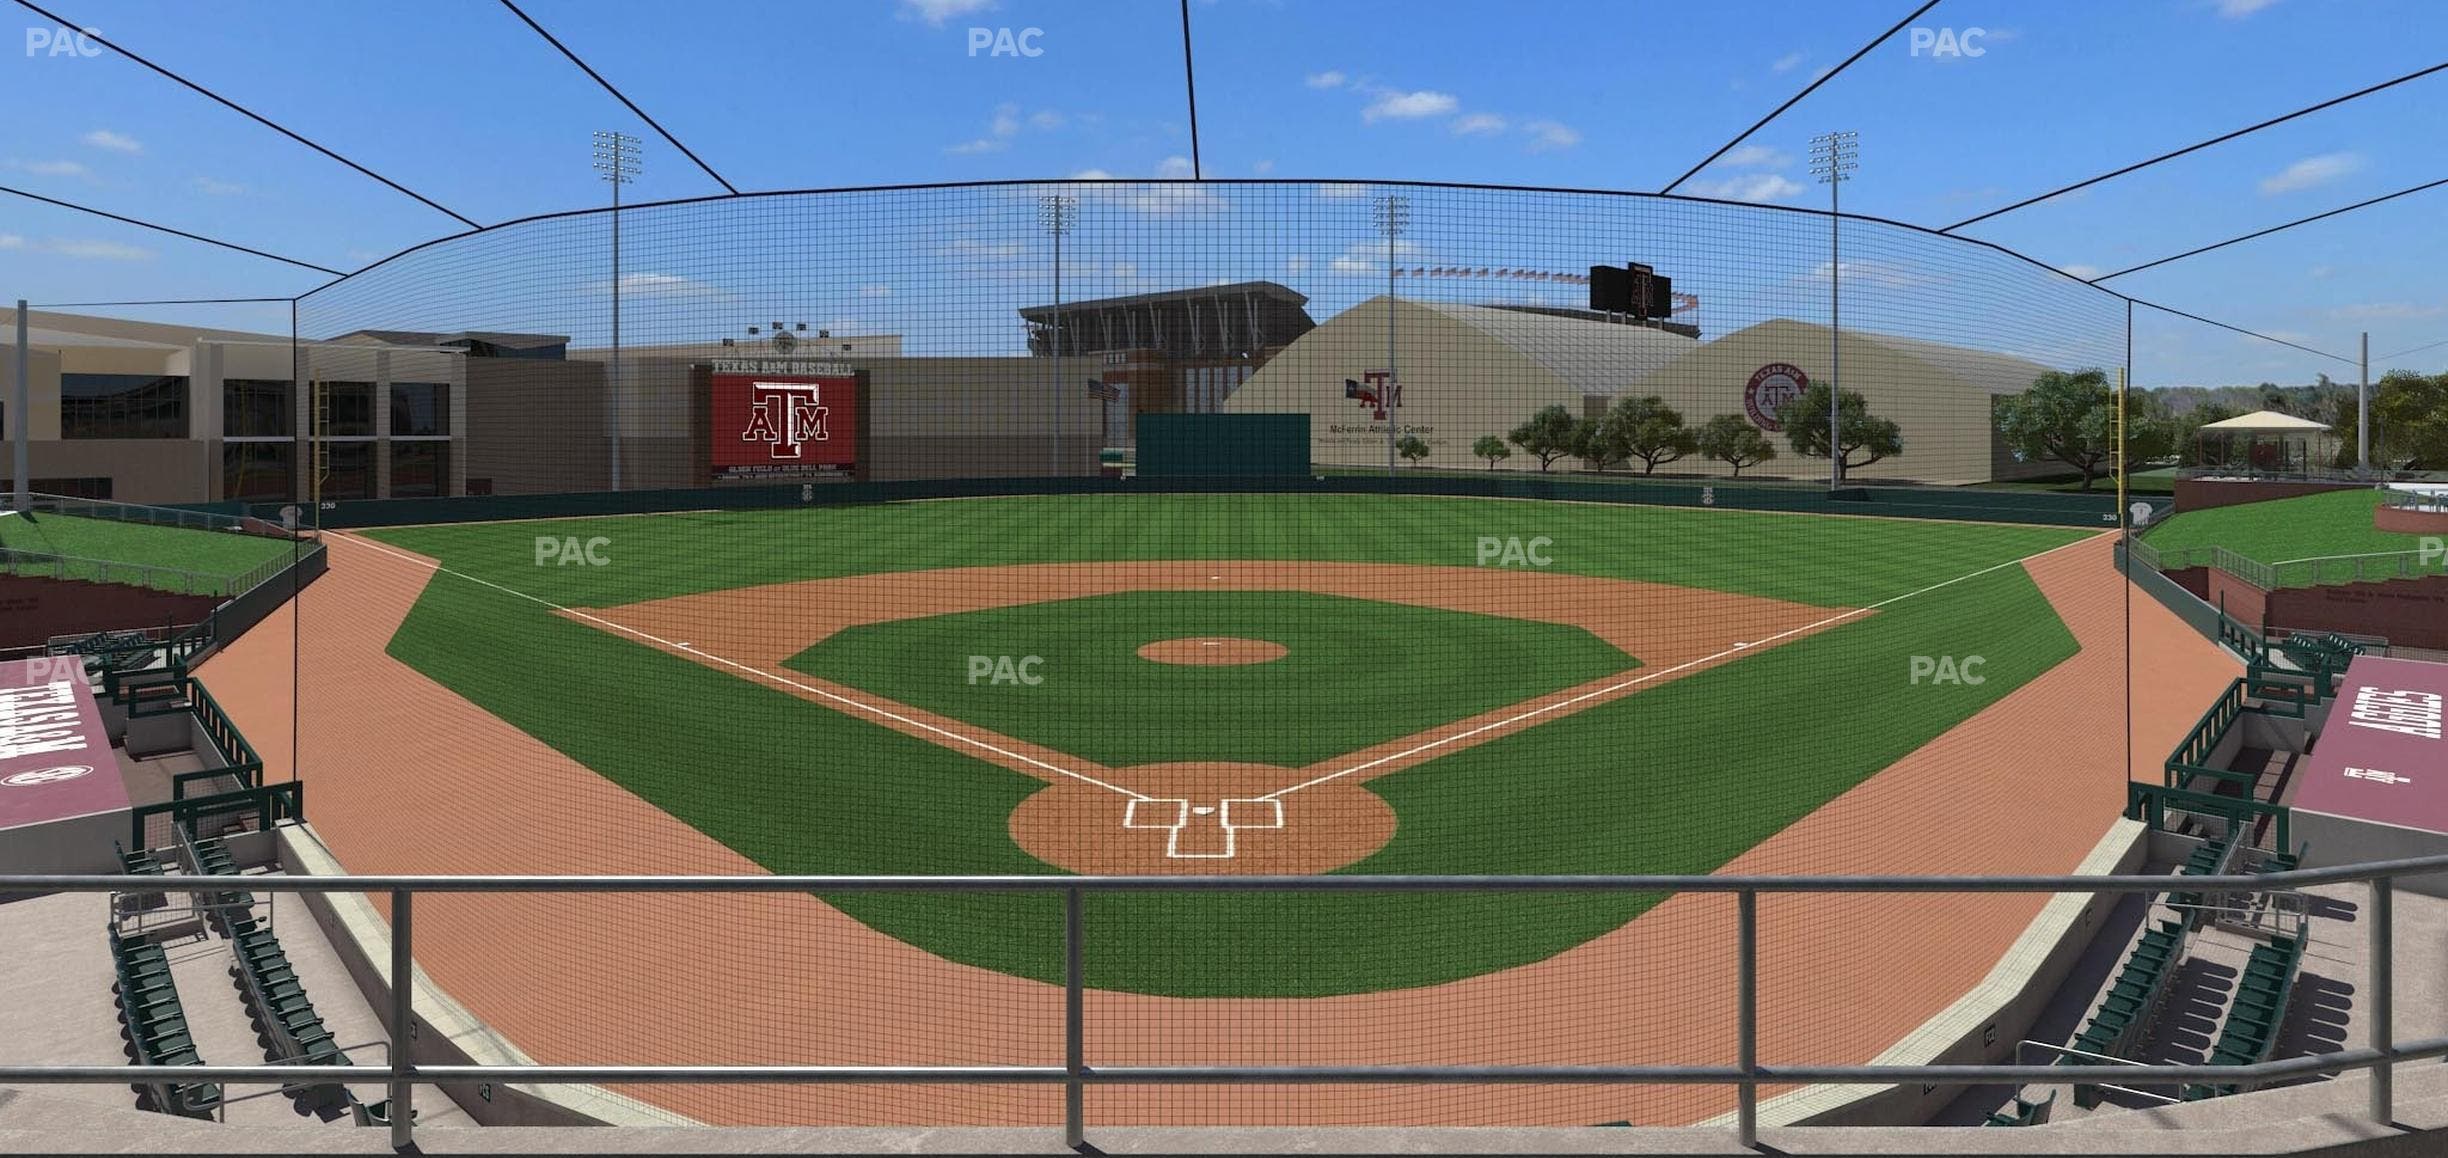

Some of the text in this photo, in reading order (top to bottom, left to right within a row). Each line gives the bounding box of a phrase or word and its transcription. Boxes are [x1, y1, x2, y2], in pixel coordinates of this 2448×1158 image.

[711, 359, 758, 375] TEXAS
[791, 362, 856, 377] BASEBALL
[1330, 425, 1434, 434] McFerrin Athleic Center
[2348, 686, 2443, 739] AGGIES
